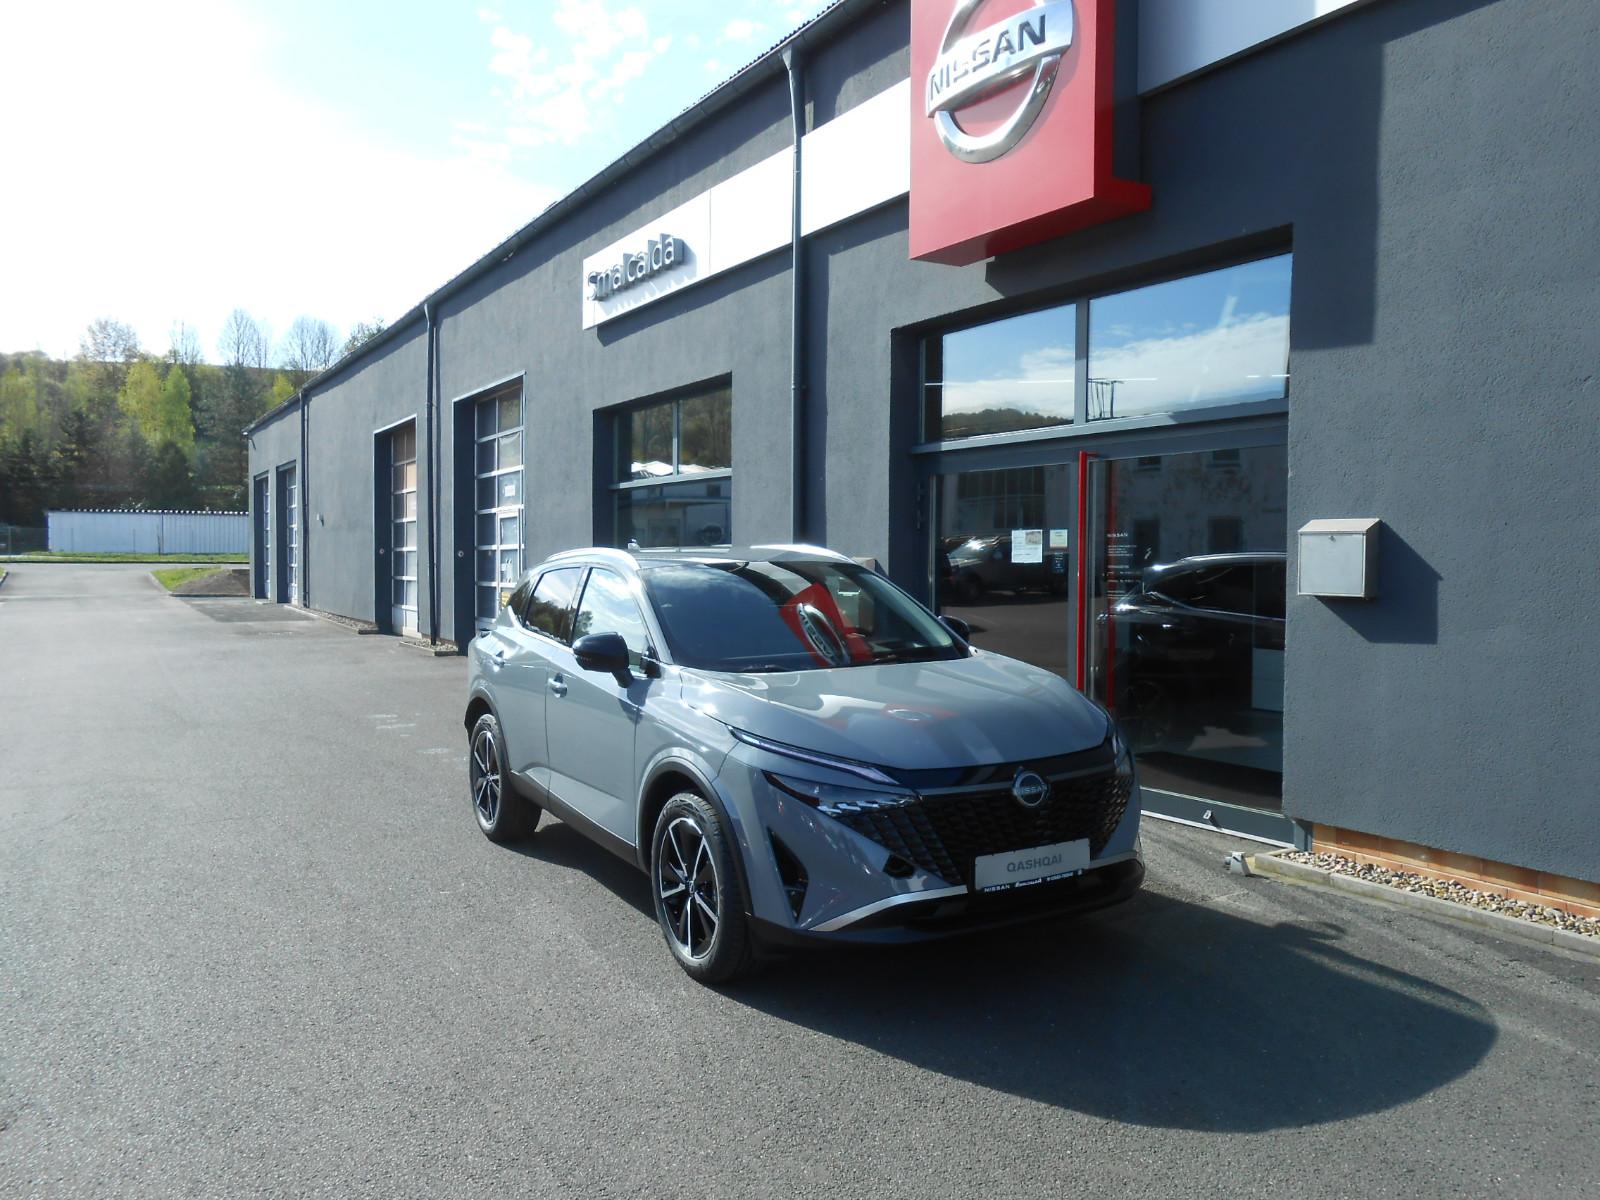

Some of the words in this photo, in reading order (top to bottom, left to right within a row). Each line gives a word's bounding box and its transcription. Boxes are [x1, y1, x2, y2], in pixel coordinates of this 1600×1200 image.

[930, 14, 1047, 102] NISSAN
[1006, 854, 1062, 873] QASHQAI
[984, 884, 1010, 893] NISSAN
